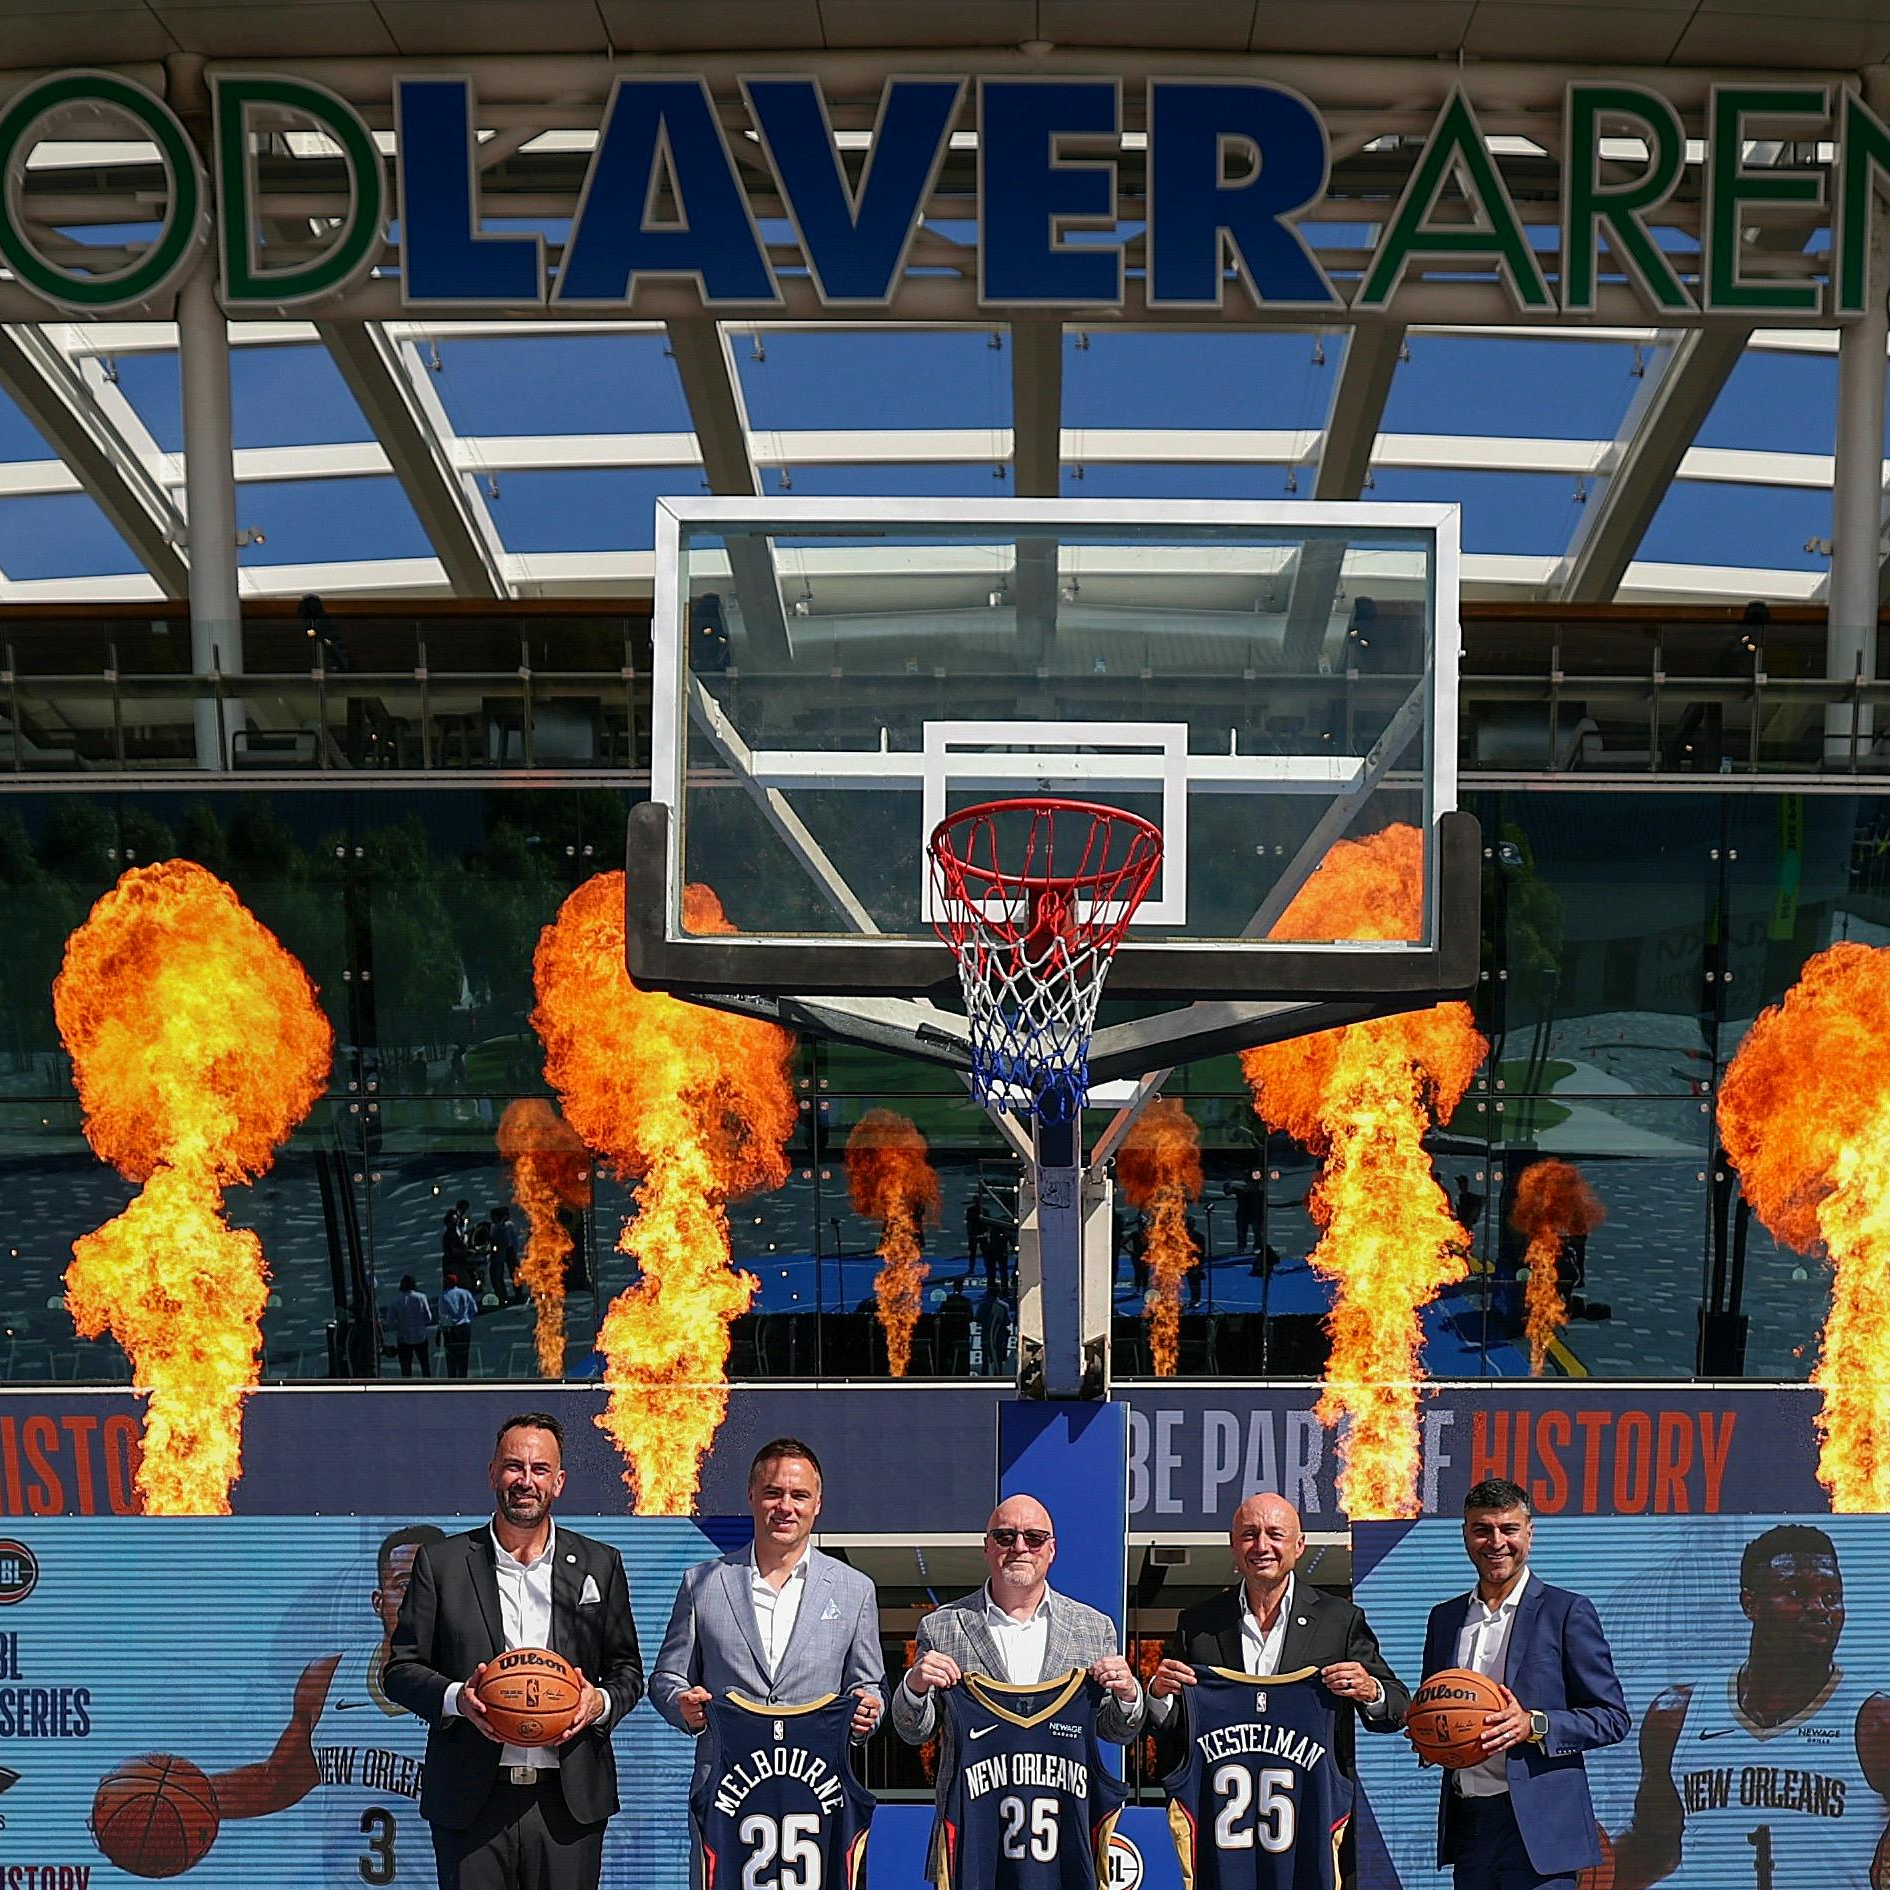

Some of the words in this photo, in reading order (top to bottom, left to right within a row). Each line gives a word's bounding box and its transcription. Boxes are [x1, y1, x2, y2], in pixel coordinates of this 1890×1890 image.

[391, 73, 1347, 310] LAVER
[1471, 1411, 1738, 1514] HISTORY
[498, 1652, 566, 1676] Wilson
[1416, 1684, 1477, 1706] Wilson
[1049, 1722, 1083, 1733] NEWAGE
[1197, 1723, 1326, 1772] KESTELMAN
[362, 1748, 425, 1800] ORLEA
[714, 1747, 845, 1818] MELBOURNE
[965, 1753, 1008, 1800] NEW
[1011, 1753, 1088, 1799] ORLEANS
[1684, 1768, 1735, 1816] NEW
[1740, 1767, 1847, 1818] ORLEANS
[999, 1795, 1059, 1863] 25
[1213, 1764, 1295, 1853] 25
[359, 1806, 397, 1887] 3
